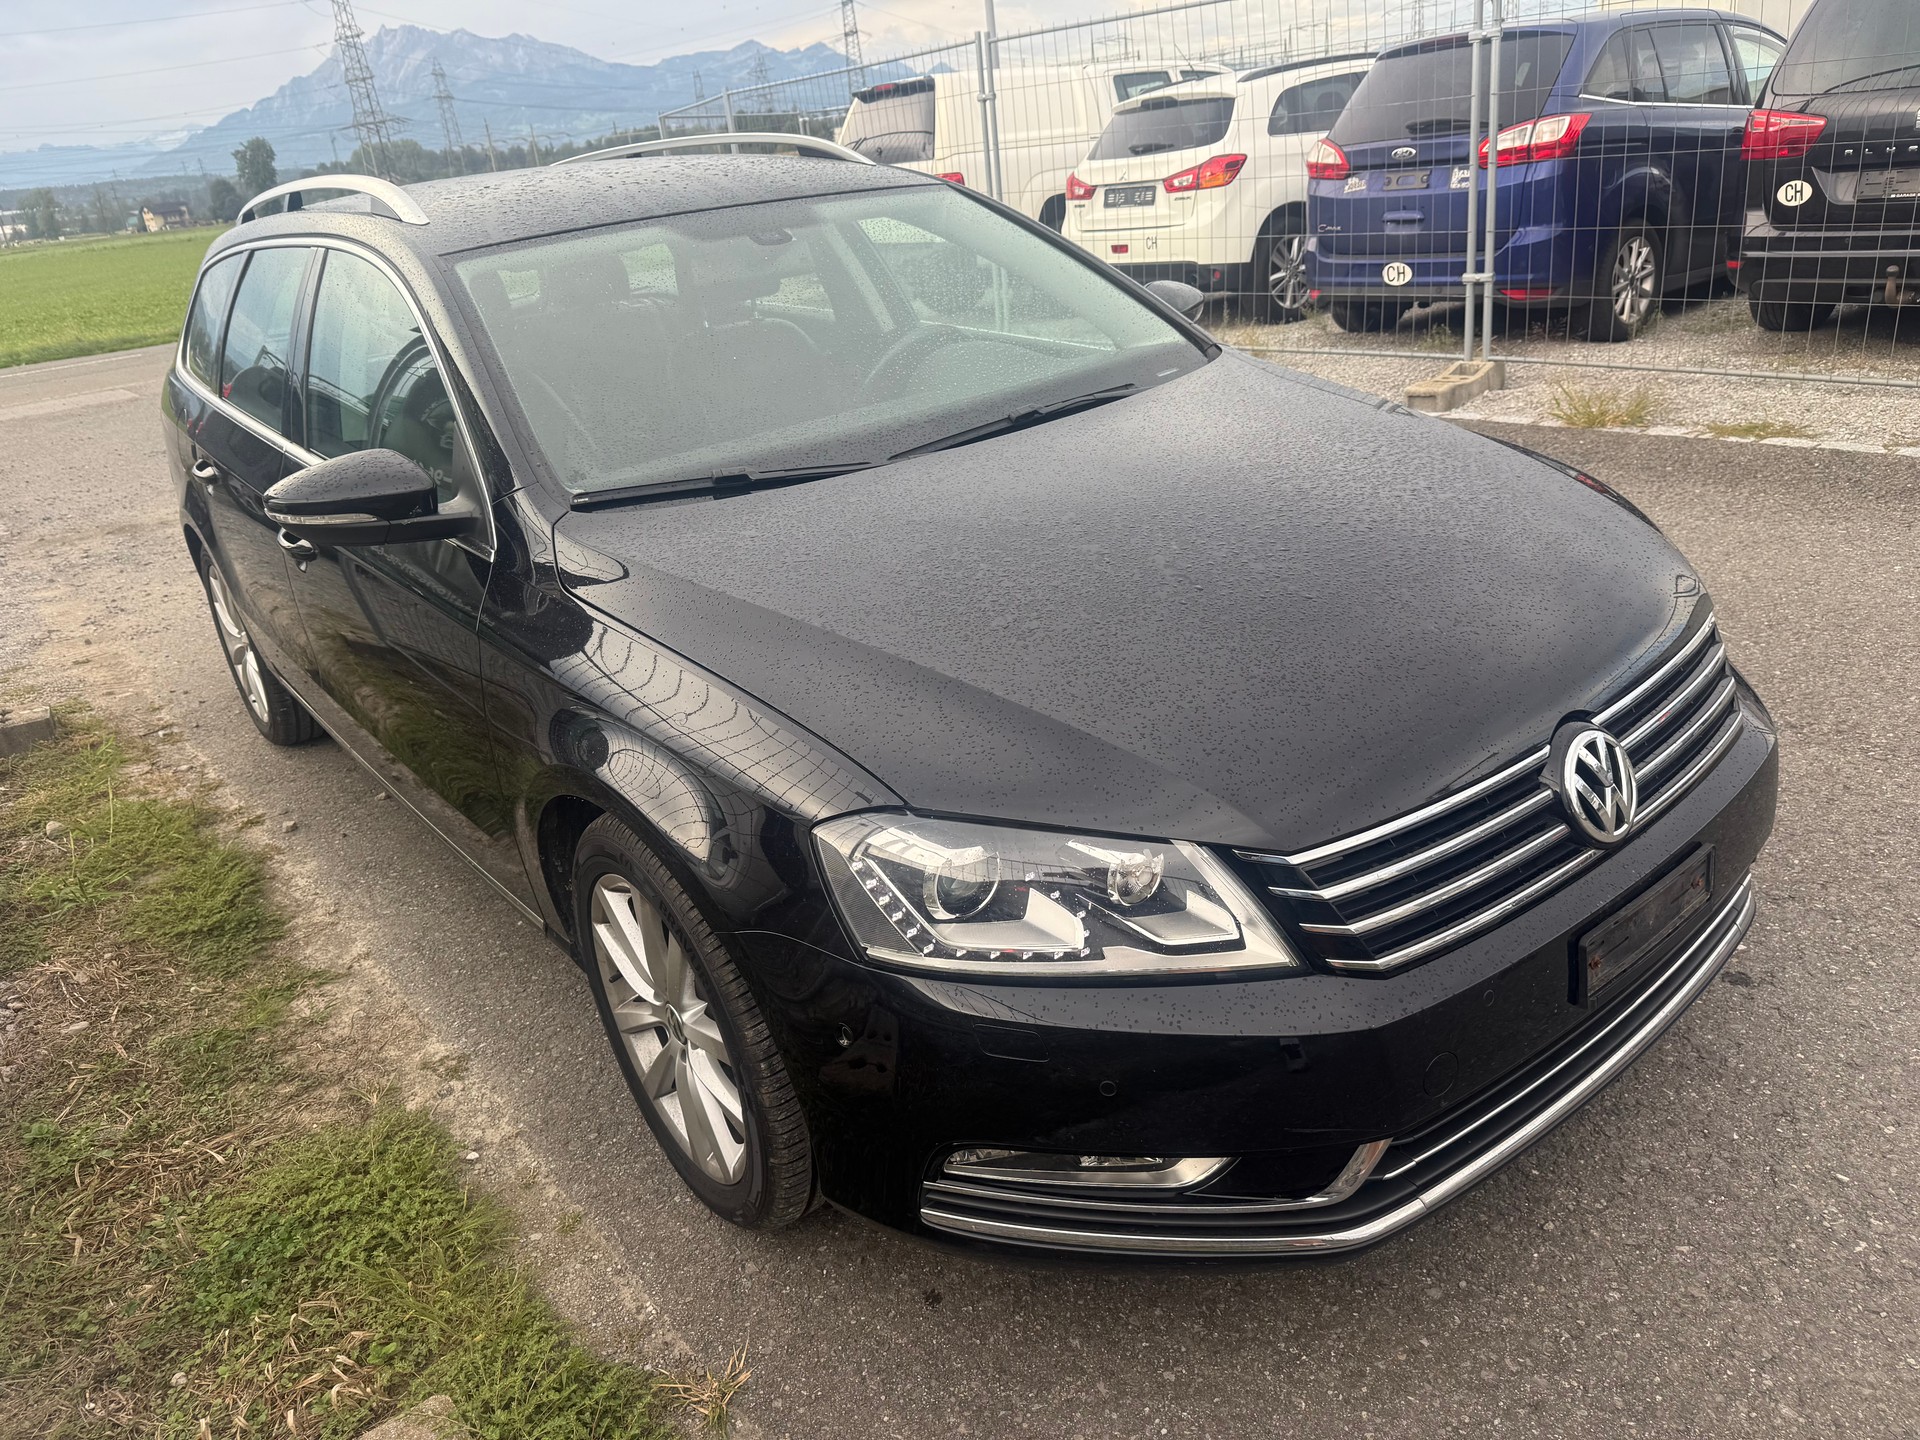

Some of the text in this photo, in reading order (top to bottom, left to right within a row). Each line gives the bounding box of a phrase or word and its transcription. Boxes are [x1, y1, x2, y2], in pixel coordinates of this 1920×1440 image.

[1785, 183, 1804, 202] CH
[1146, 237, 1158, 250] CH
[1386, 265, 1406, 282] CH
[1565, 731, 1637, 842] VW
